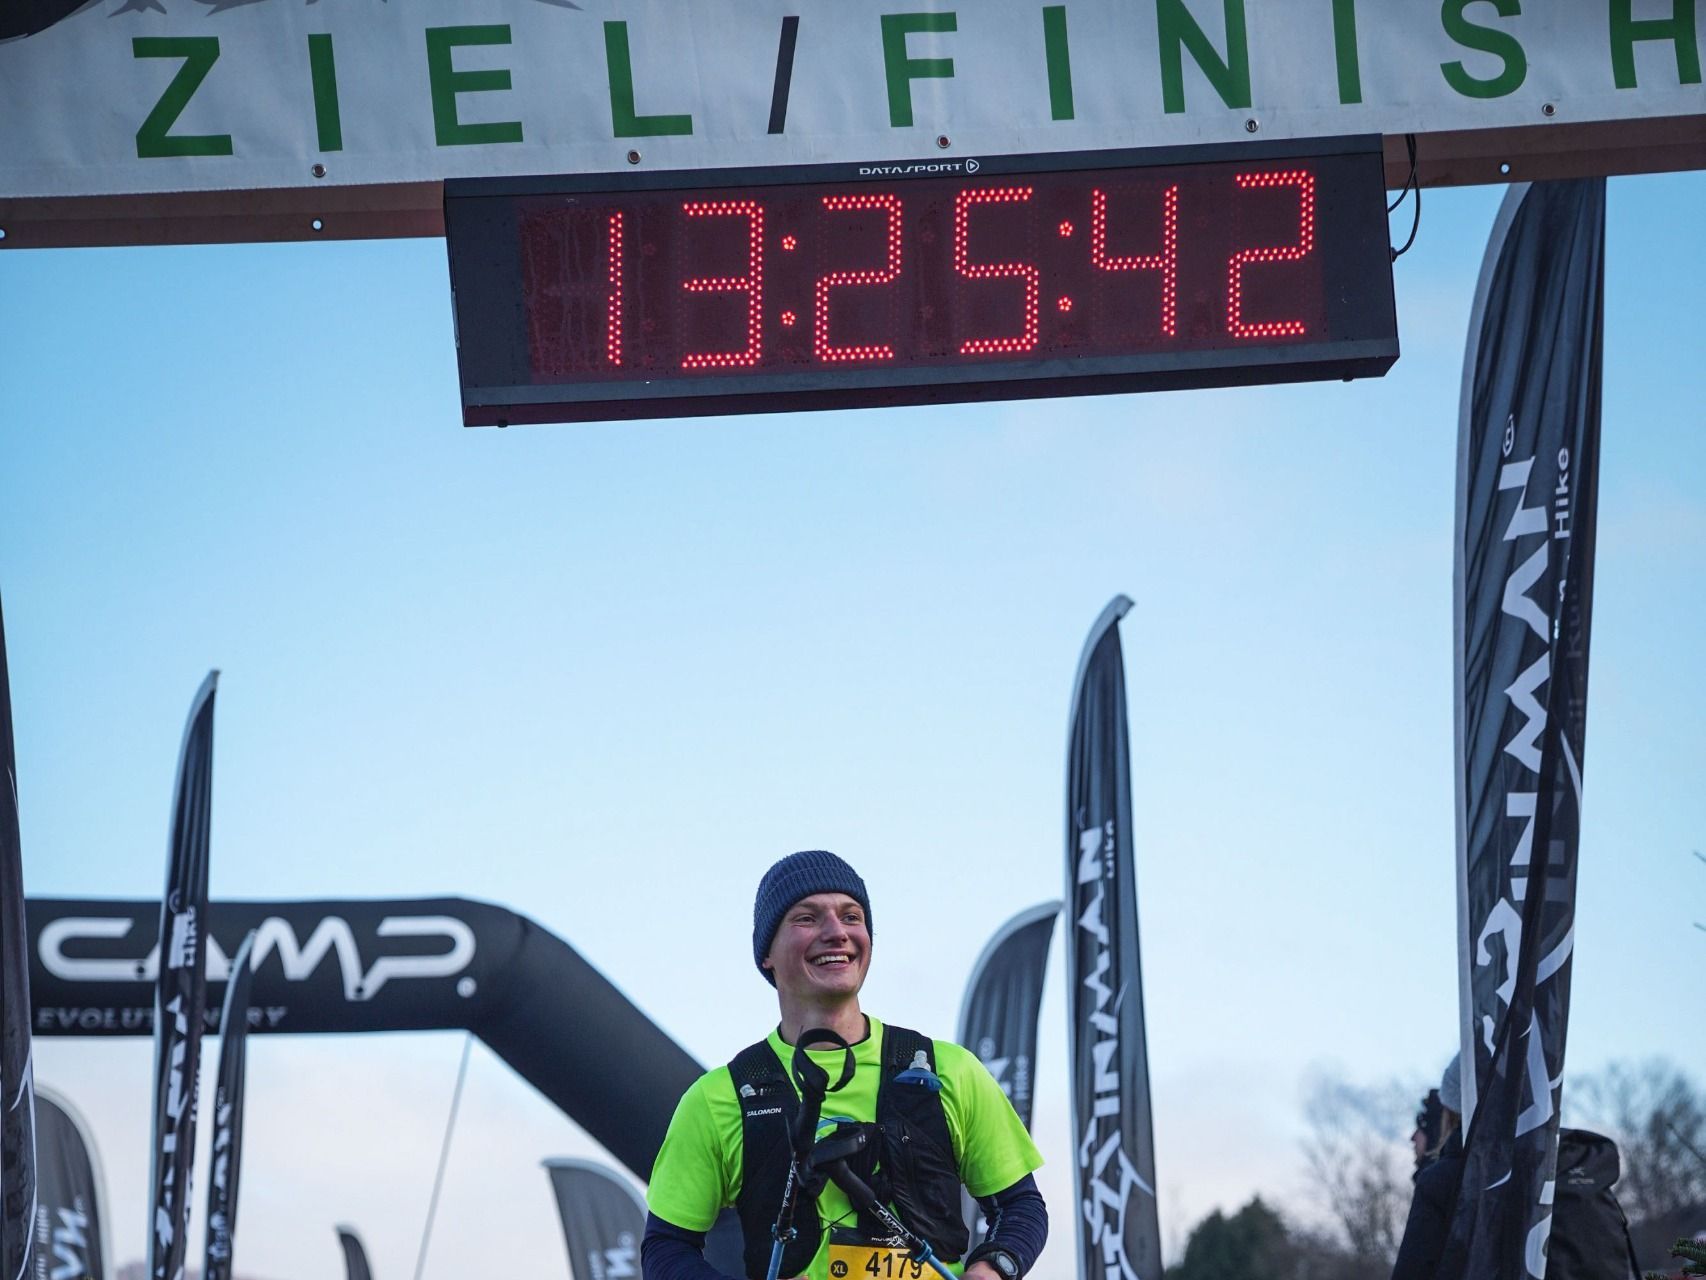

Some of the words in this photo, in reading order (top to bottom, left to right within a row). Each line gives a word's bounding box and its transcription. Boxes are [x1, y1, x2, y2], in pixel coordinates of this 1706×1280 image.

[859, 163, 962, 175] DATASPORT
[607, 170, 1315, 368] 13:25:42
[1554, 447, 1570, 540] Hike
[746, 1107, 782, 1117] SALOMON
[833, 1264, 846, 1275] XL
[865, 1251, 923, 1280] 4179
